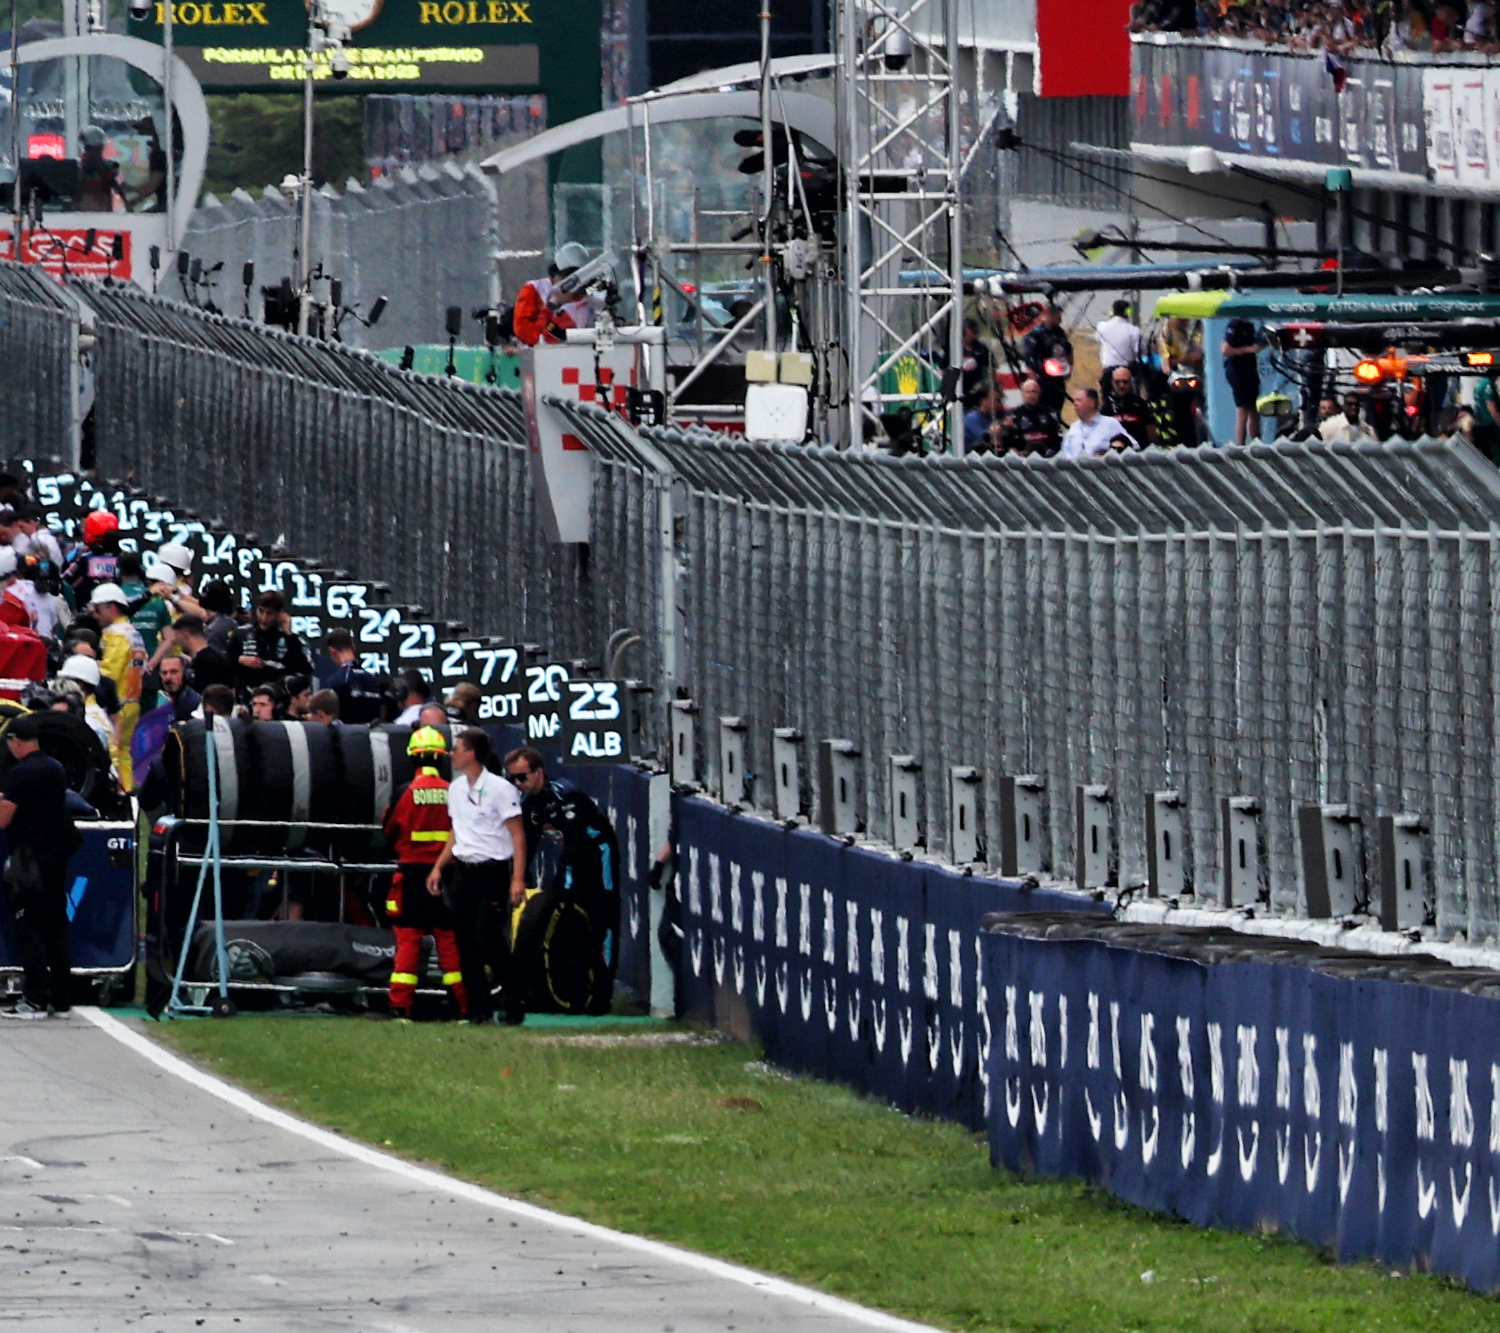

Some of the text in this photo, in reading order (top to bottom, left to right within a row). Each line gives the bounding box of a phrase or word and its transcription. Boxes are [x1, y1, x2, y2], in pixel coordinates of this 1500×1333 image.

[155, 0, 532, 25] ROLEX ROLEX
[202, 533, 237, 564] 14
[292, 572, 324, 607] 11
[474, 647, 518, 685] 77
[478, 693, 522, 719] BOT
[568, 682, 621, 721] 23
[570, 731, 623, 757] ALB
